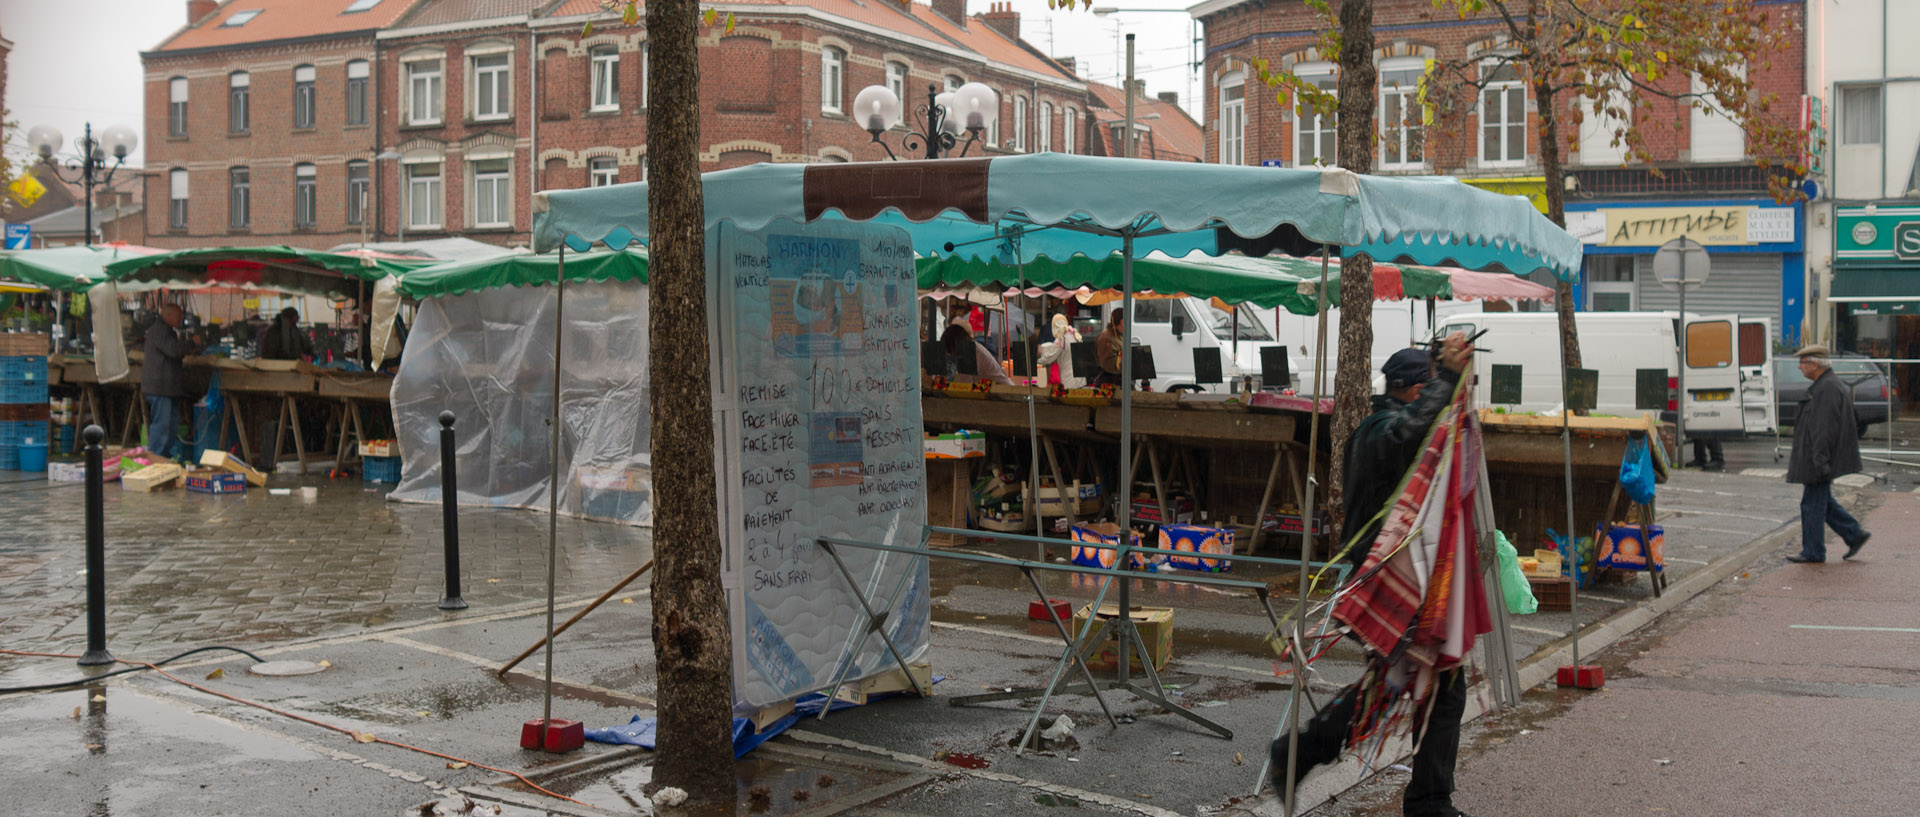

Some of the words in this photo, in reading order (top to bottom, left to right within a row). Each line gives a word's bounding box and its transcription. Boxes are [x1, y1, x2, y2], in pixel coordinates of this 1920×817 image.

[1749, 210, 1791, 219] COIFFEUR
[1611, 209, 1741, 244] ATTITUDE
[1749, 221, 1791, 229] MIXTE
[1749, 231, 1791, 239] STYLISTE
[779, 241, 849, 259] HARMONY
[735, 253, 772, 269] MATELAS
[862, 311, 911, 330] LIVRAISON
[864, 337, 911, 353] GRATUITE
[740, 381, 786, 404] REMISE
[805, 356, 852, 410] 100
[865, 376, 915, 394] DOMICILE
[742, 411, 766, 429] FACE
[770, 410, 800, 428] HIVER
[861, 404, 892, 425] SANS
[866, 427, 915, 448] RESSORT
[765, 491, 779, 505] DE
[743, 509, 793, 531] PAIEMENT
[748, 538, 757, 562] 2
[754, 570, 783, 591] SANS
